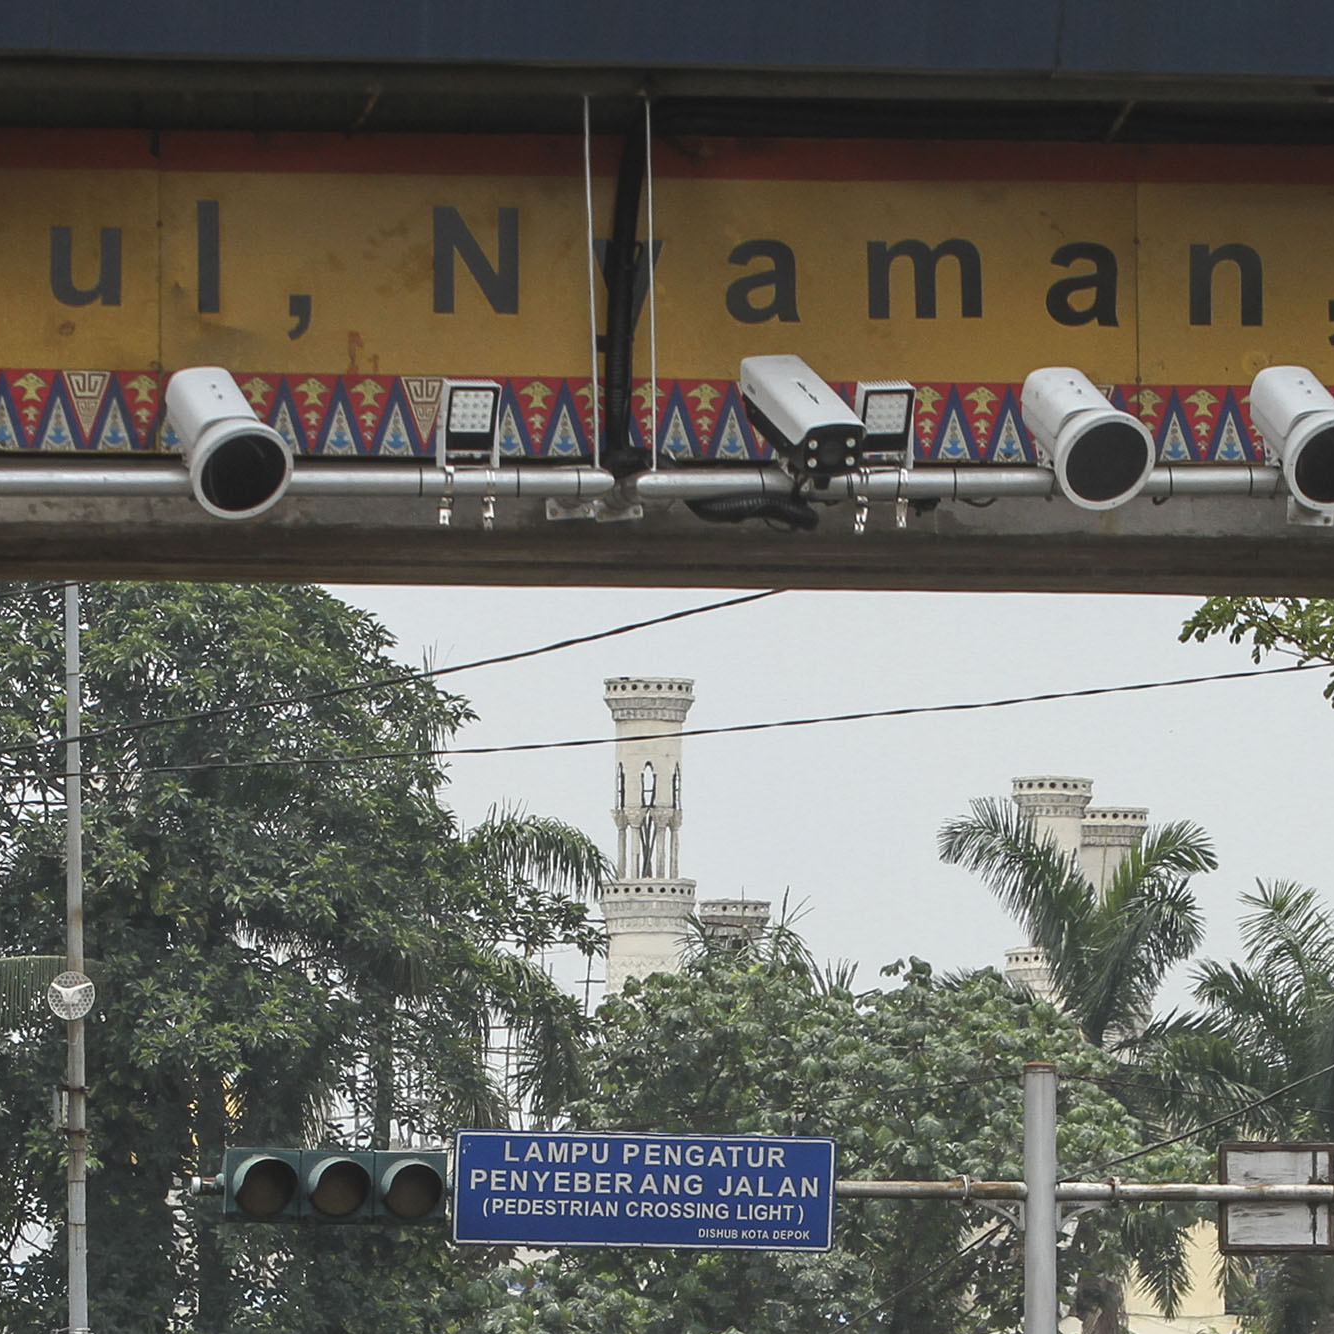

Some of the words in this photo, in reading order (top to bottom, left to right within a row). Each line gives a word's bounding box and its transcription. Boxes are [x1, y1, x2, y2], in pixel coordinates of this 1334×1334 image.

[504, 1140, 609, 1164] LAMPU
[623, 1143, 785, 1168] PENGATUR
[470, 1168, 703, 1195] PENYEBERANG
[718, 1176, 818, 1198] JALAN
[483, 1197, 618, 1217] (PEDESTRIAN
[625, 1201, 729, 1220] CROSSING
[698, 1228, 738, 1239] DISHUB
[741, 1230, 769, 1240] KOTA
[772, 1231, 810, 1240] DEPOK
